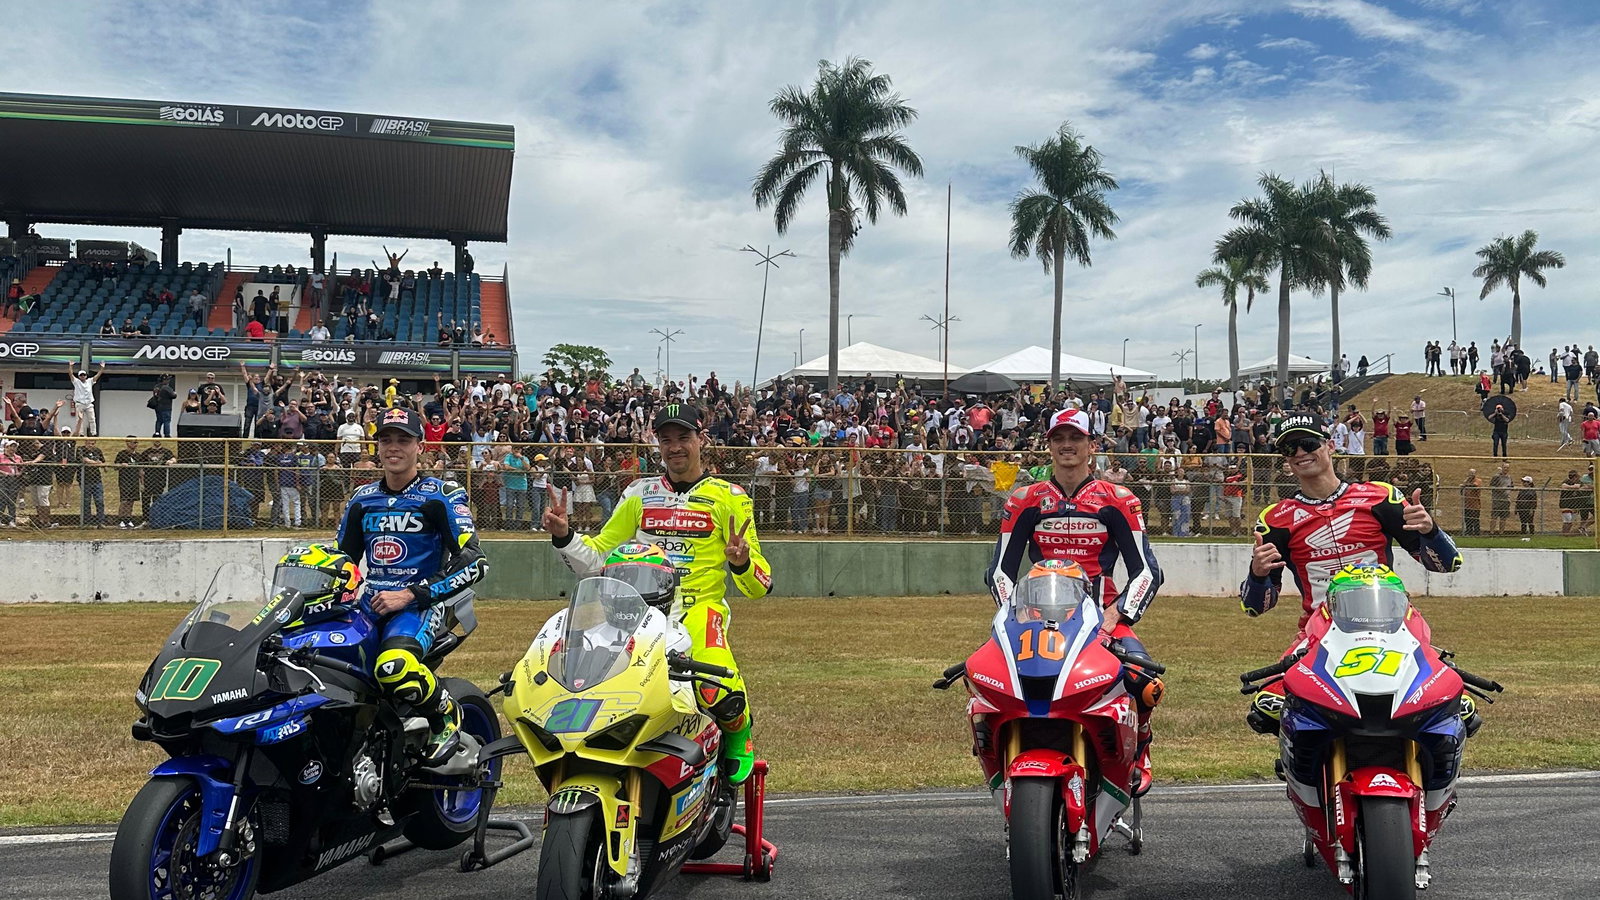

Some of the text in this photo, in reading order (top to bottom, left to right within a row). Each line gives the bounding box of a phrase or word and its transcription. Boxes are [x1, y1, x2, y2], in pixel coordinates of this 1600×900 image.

[387, 119, 430, 132] BRASIL
[133, 344, 230, 360] MotoGP
[392, 351, 430, 361] BRASIL
[1280, 415, 1313, 430] SUHAI
[645, 516, 708, 528] Enduro
[1053, 521, 1098, 531] Castrol
[656, 538, 693, 554] ebay
[1038, 535, 1103, 545] HONDA
[1310, 541, 1366, 558] HONDA
[1017, 628, 1066, 662] 10
[1333, 645, 1409, 679] 51
[148, 657, 223, 702] 10
[972, 672, 1005, 690] HONDA
[1074, 673, 1113, 690] HONDA
[211, 687, 249, 705] YAMAHA
[544, 698, 604, 733] 21
[314, 831, 377, 872] YAMAHA
